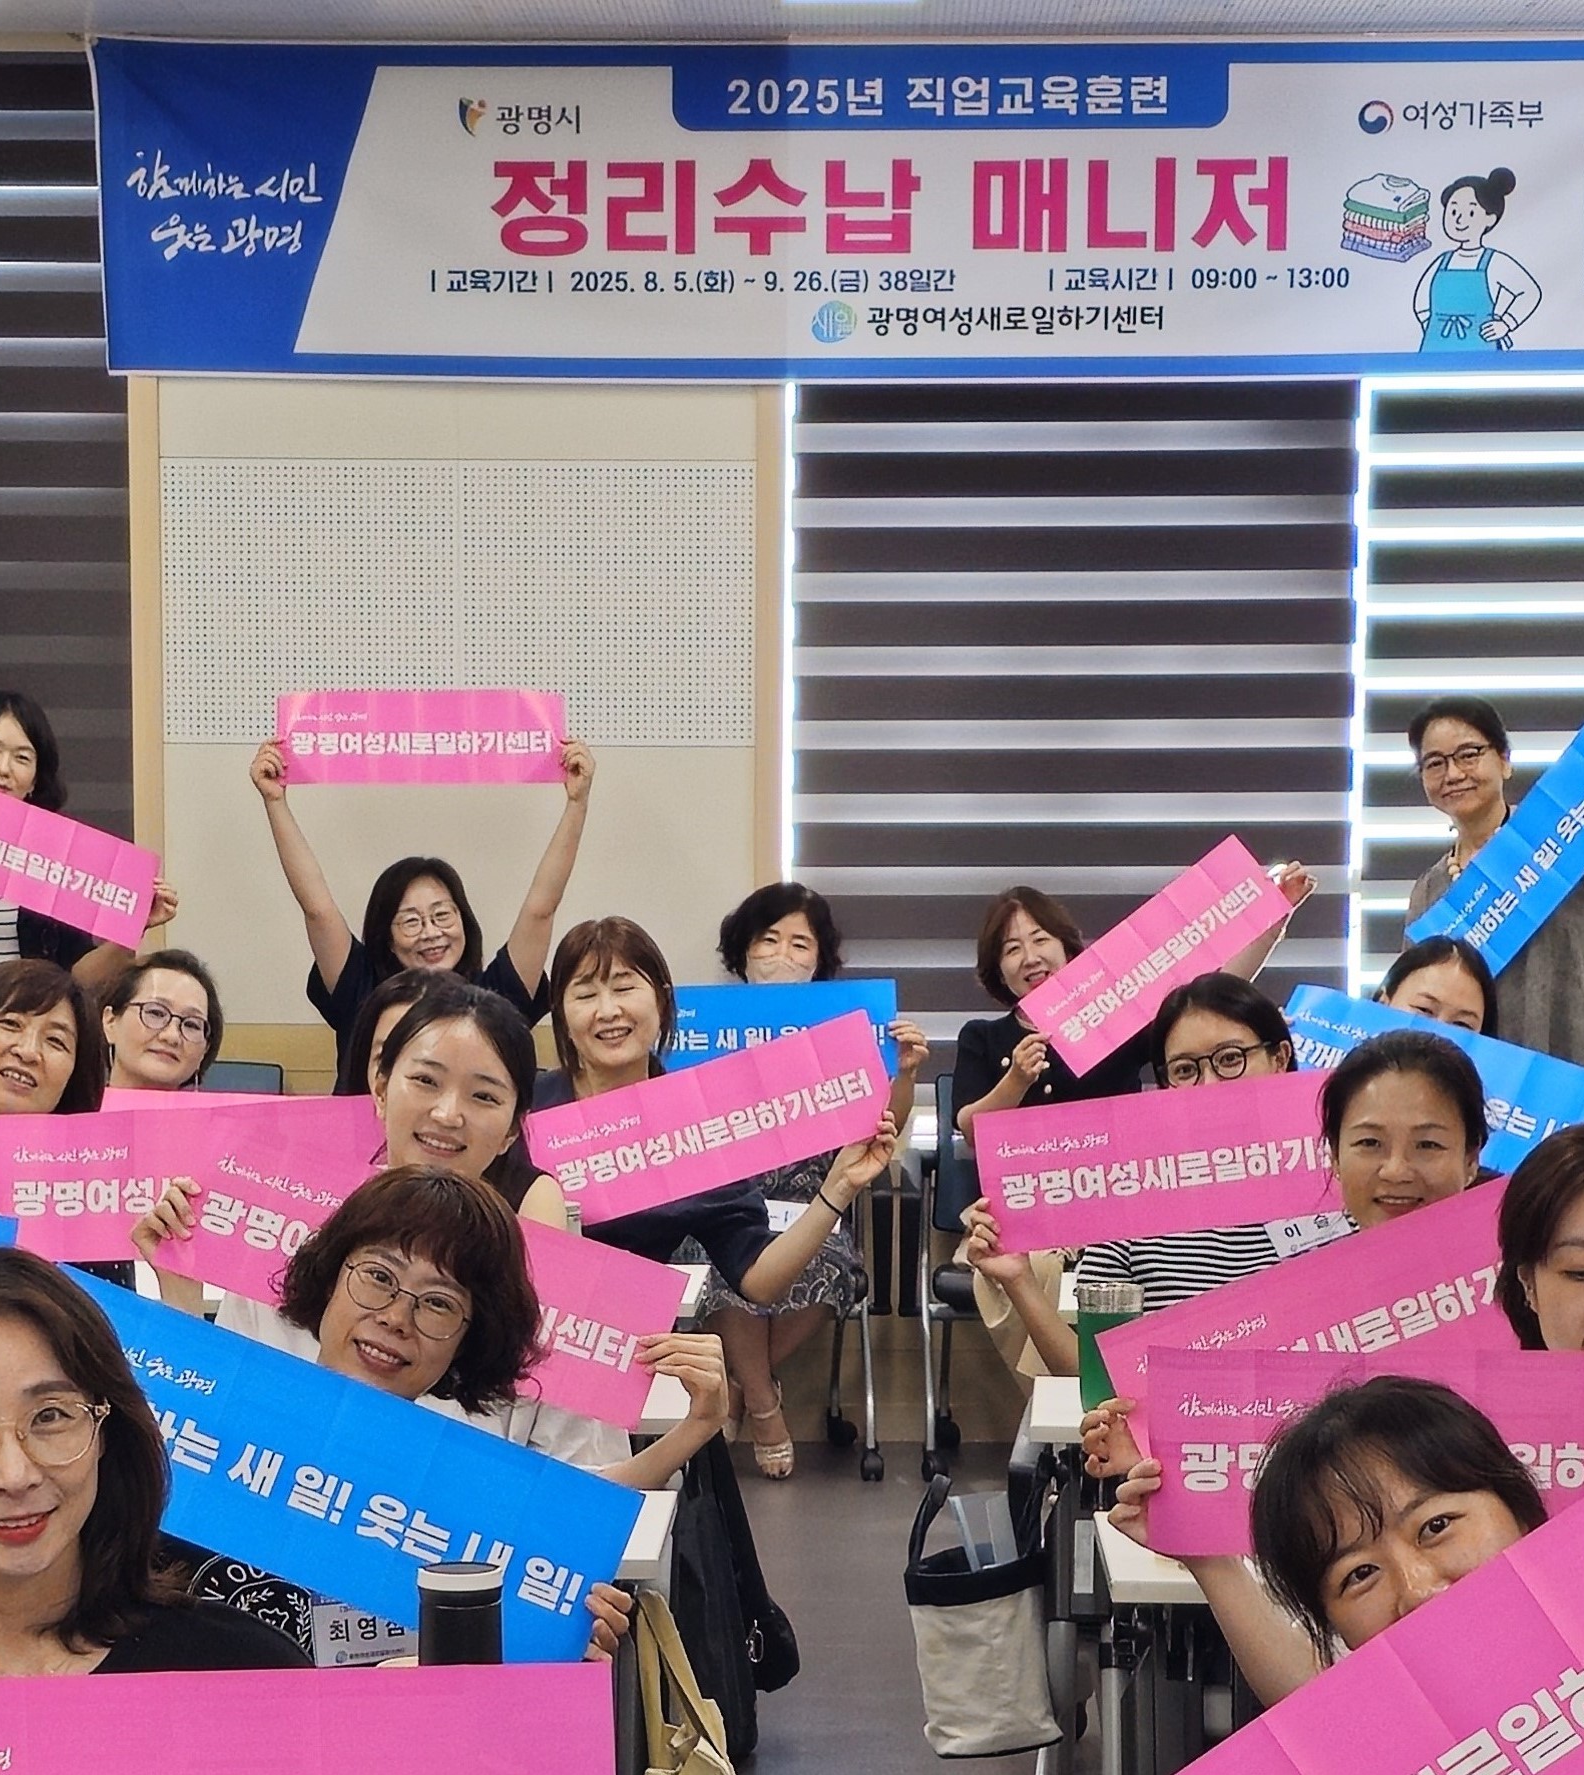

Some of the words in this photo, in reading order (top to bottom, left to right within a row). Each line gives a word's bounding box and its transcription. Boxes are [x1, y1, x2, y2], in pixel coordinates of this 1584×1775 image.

[728, 78, 882, 115] 2025년
[907, 75, 1167, 115] 직업교육훈련
[497, 105, 580, 134] 광명시
[1403, 101, 1543, 130] 여성가족부
[254, 163, 324, 204] 시민
[490, 157, 922, 256] 정리수납
[972, 155, 1293, 253] 매니저
[221, 216, 304, 258] 광명
[447, 270, 537, 292] 교육기간
[879, 270, 955, 292] 38일간
[1065, 268, 1156, 290] 교육시간
[1192, 269, 1256, 289] 09:00
[1288, 268, 1349, 288] 13:00
[868, 306, 1163, 336] 광명여성새로일하기센터
[291, 726, 552, 755] 광명여성새로일하기센터
[1059, 877, 1262, 1042] 광명여성새로일하기센터
[556, 1068, 872, 1191] 광명여성새로일하기센터
[1001, 1136, 1331, 1209] 광명여성새로일하기
[227, 1443, 283, 1497] 새
[287, 1466, 353, 1524] 일!
[360, 1494, 452, 1565] 웃는
[516, 1556, 584, 1615] 일!
